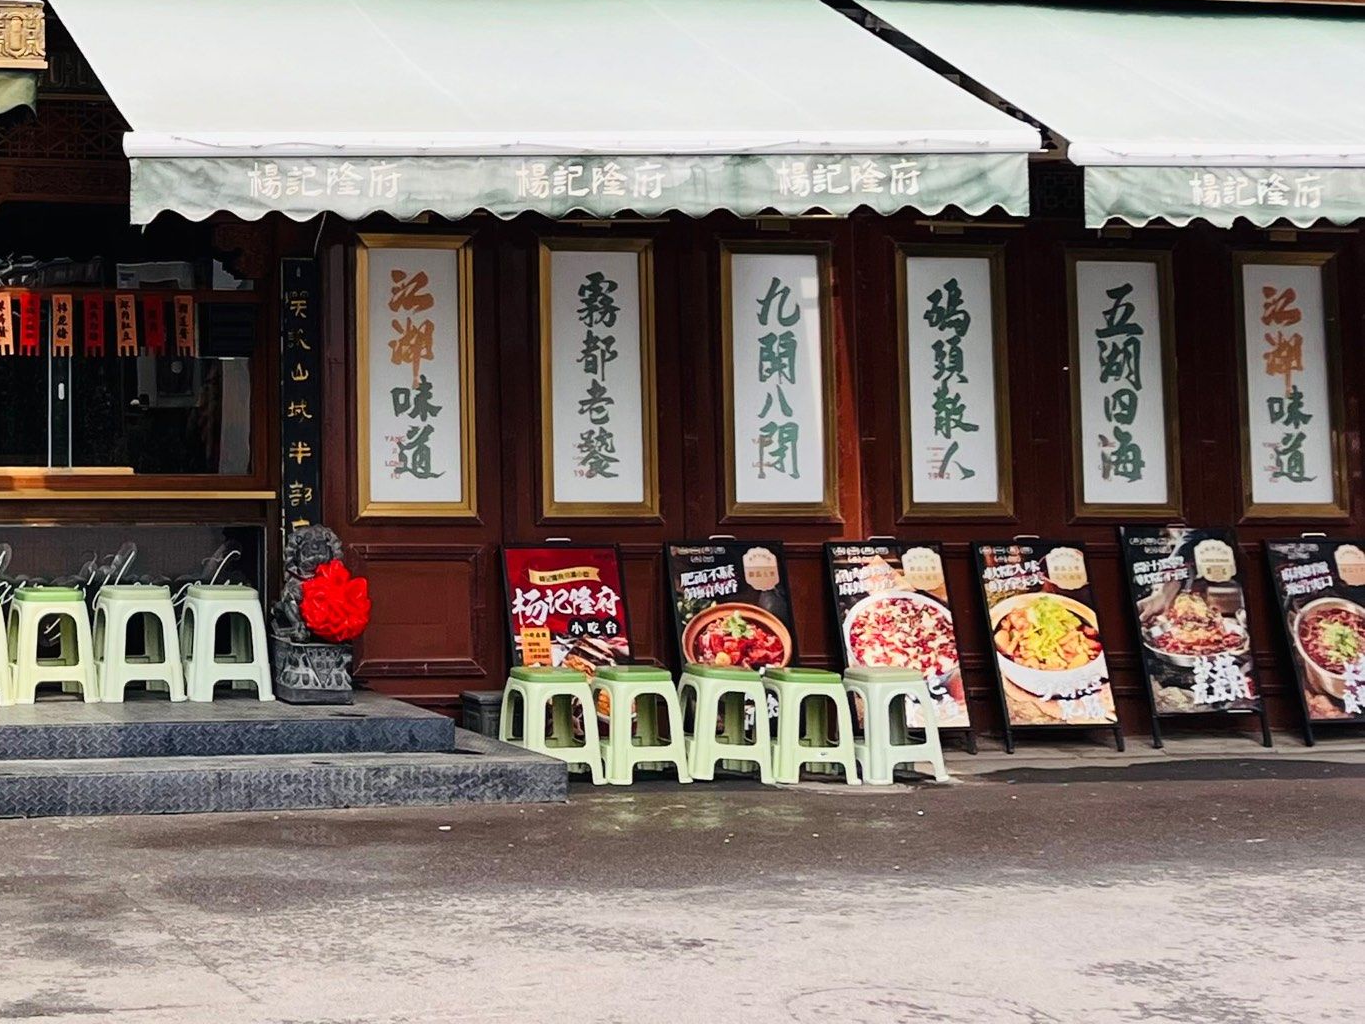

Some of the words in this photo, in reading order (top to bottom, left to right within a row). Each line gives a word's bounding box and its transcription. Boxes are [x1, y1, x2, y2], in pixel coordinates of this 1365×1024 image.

[248, 161, 401, 200] 楊記隆府
[516, 162, 665, 200] 楊記隆府
[777, 160, 921, 197] 楊記隆府
[1189, 171, 1325, 209] 楊記隆府
[387, 268, 447, 480] 江湖味道
[1095, 283, 1144, 483] 五湖四海
[1260, 285, 1317, 483] 江湖味道
[512, 585, 620, 626] 杨记隆府
